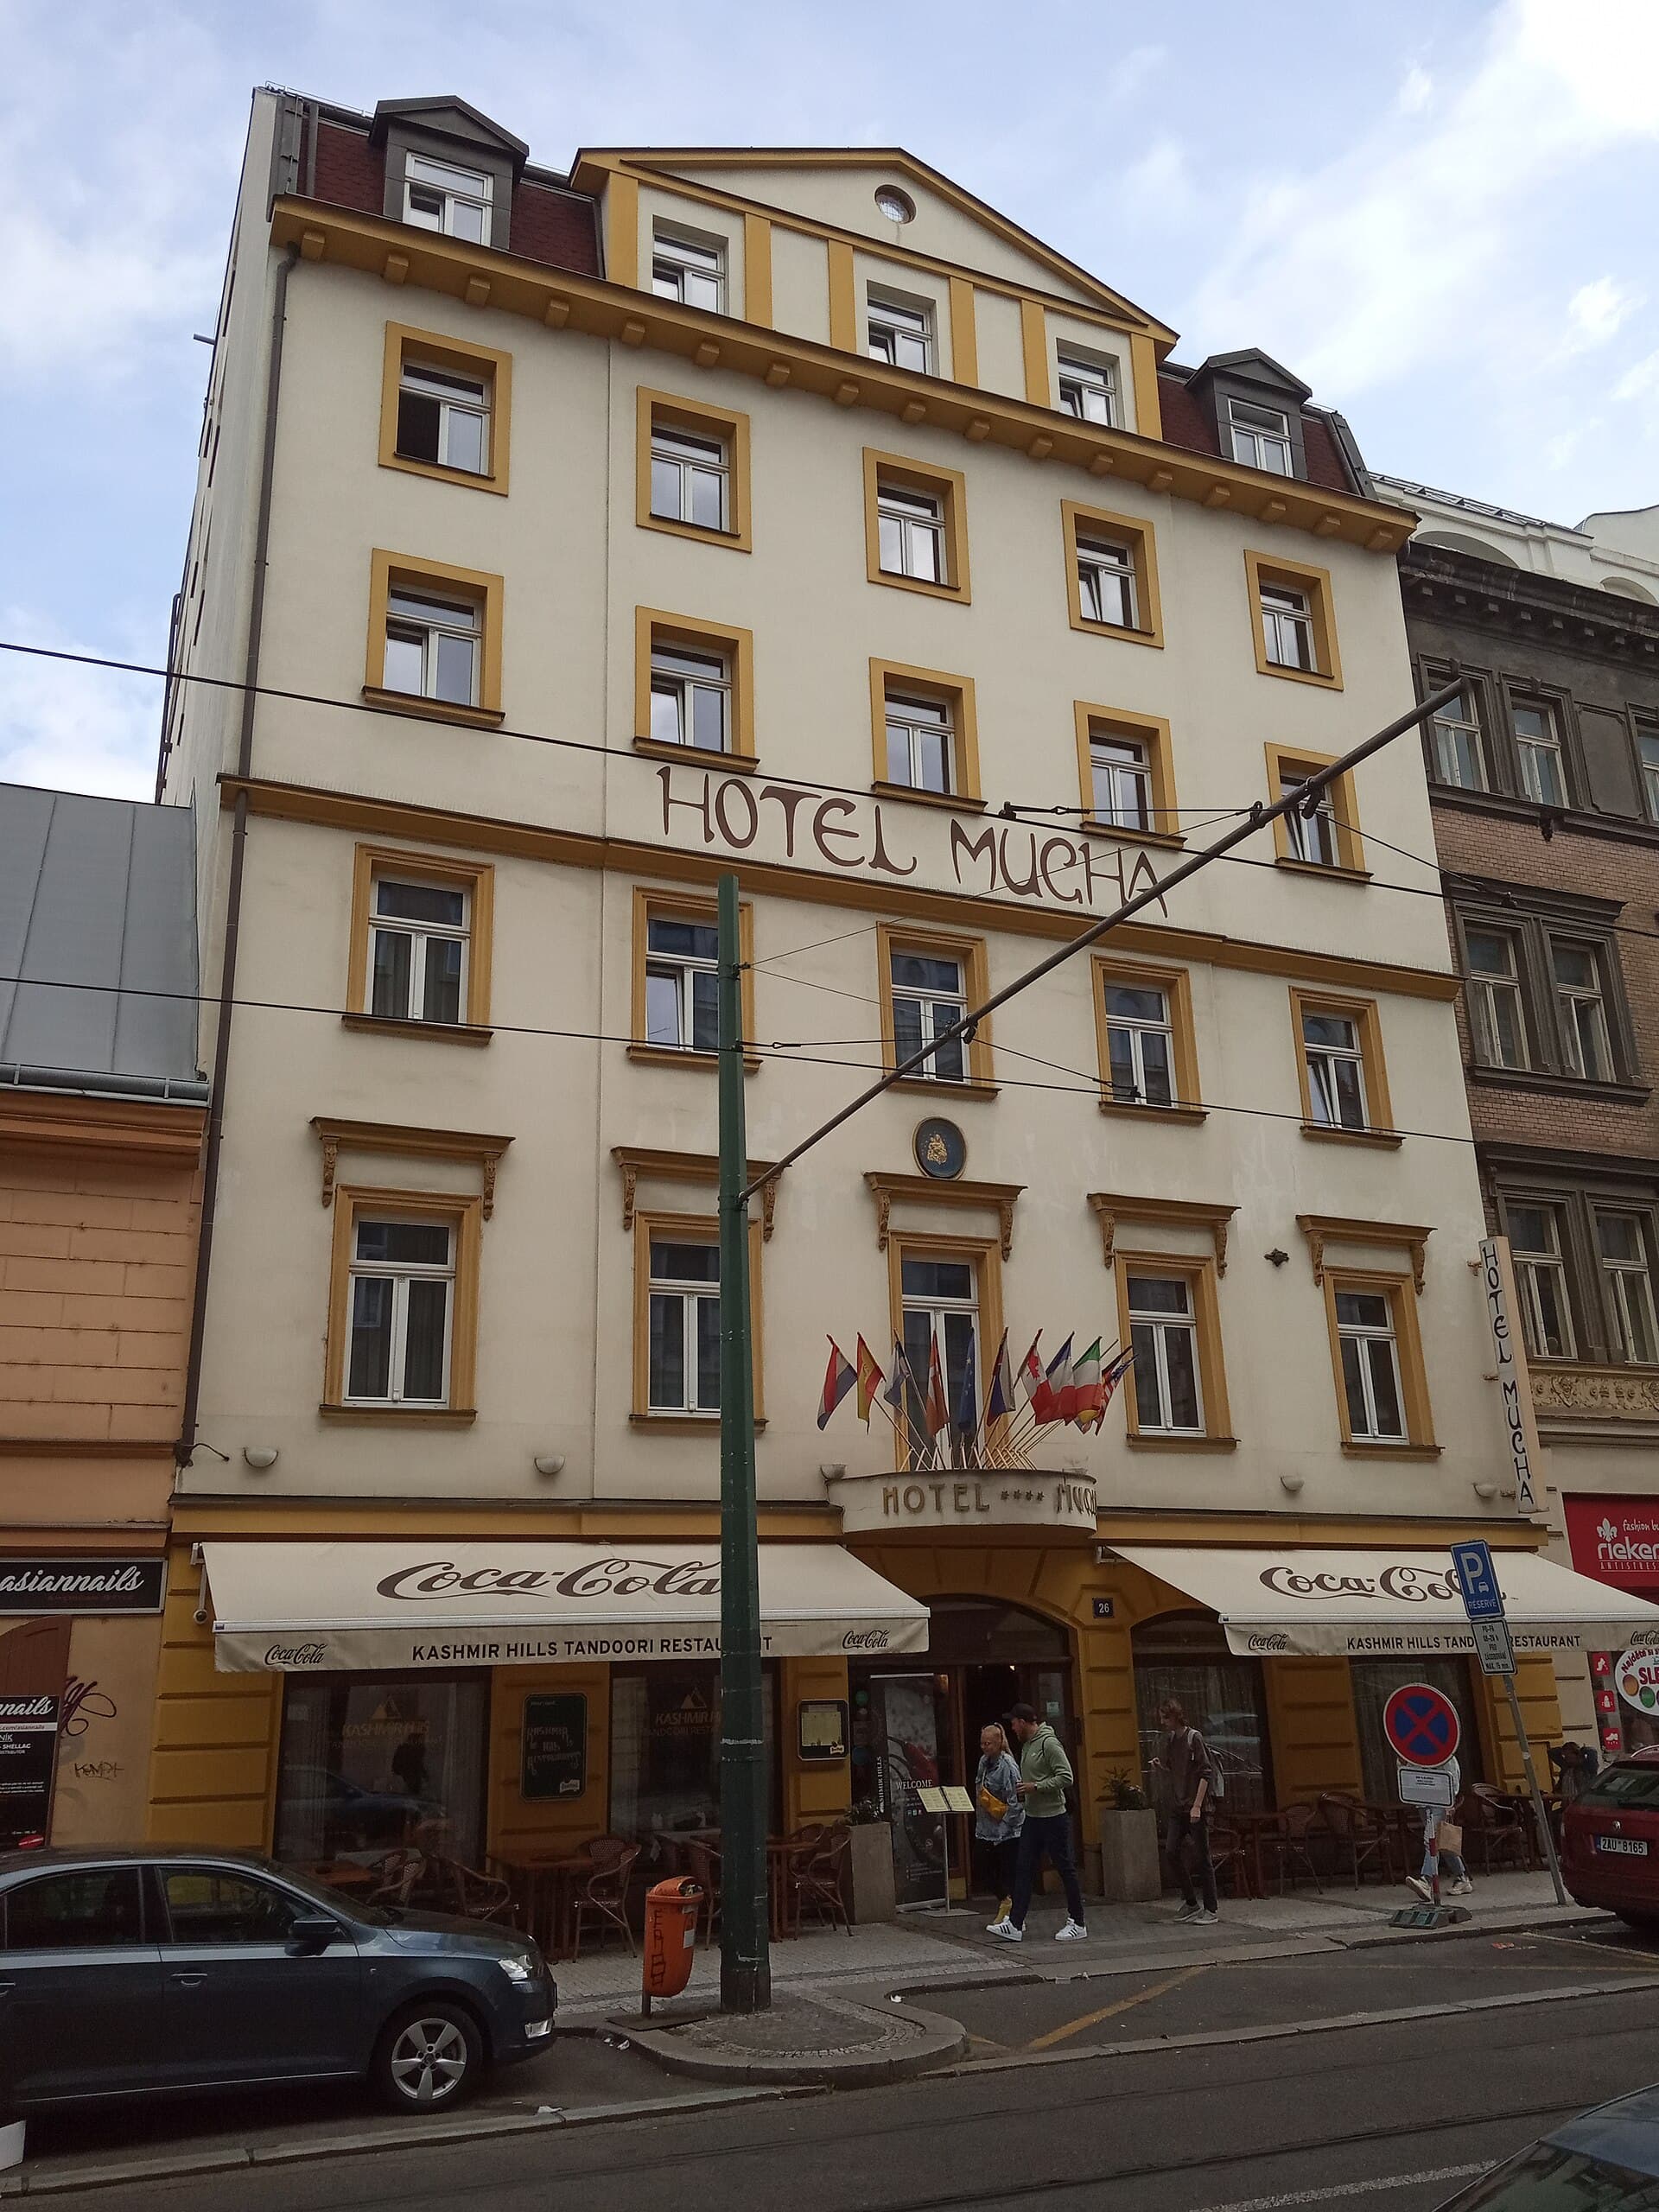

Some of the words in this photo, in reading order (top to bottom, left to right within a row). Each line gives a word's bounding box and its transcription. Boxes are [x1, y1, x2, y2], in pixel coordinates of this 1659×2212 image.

[657, 766, 917, 875] HOTEL
[950, 818, 1168, 918] MUCHA
[1482, 1243, 1512, 1363] HOTEL
[1503, 1380, 1534, 1504] MUCHA
[882, 1483, 989, 1515] HOTEL
[1623, 1519, 1649, 1532] fashion
[1598, 1536, 1659, 1560] rieker
[0, 1566, 145, 1592] asiannails
[377, 1558, 722, 1600] Coca-Cola
[1098, 1603, 1110, 1615] 26
[412, 1644, 500, 1661] KASHMIR
[506, 1642, 557, 1657] HILLS
[564, 1639, 653, 1656] TANDOORI
[842, 1630, 890, 1649] Coca-Cola
[1249, 1633, 1288, 1650] Coca-Cola
[1347, 1637, 1403, 1649] KASHMIR
[1407, 1637, 1440, 1649] HILLS
[264, 1643, 327, 1665] Coca-Cola
[896, 1779, 933, 1790] WELCOME
[1602, 1838, 1618, 1850] 2AU
[1623, 1841, 1643, 1853] 8165
